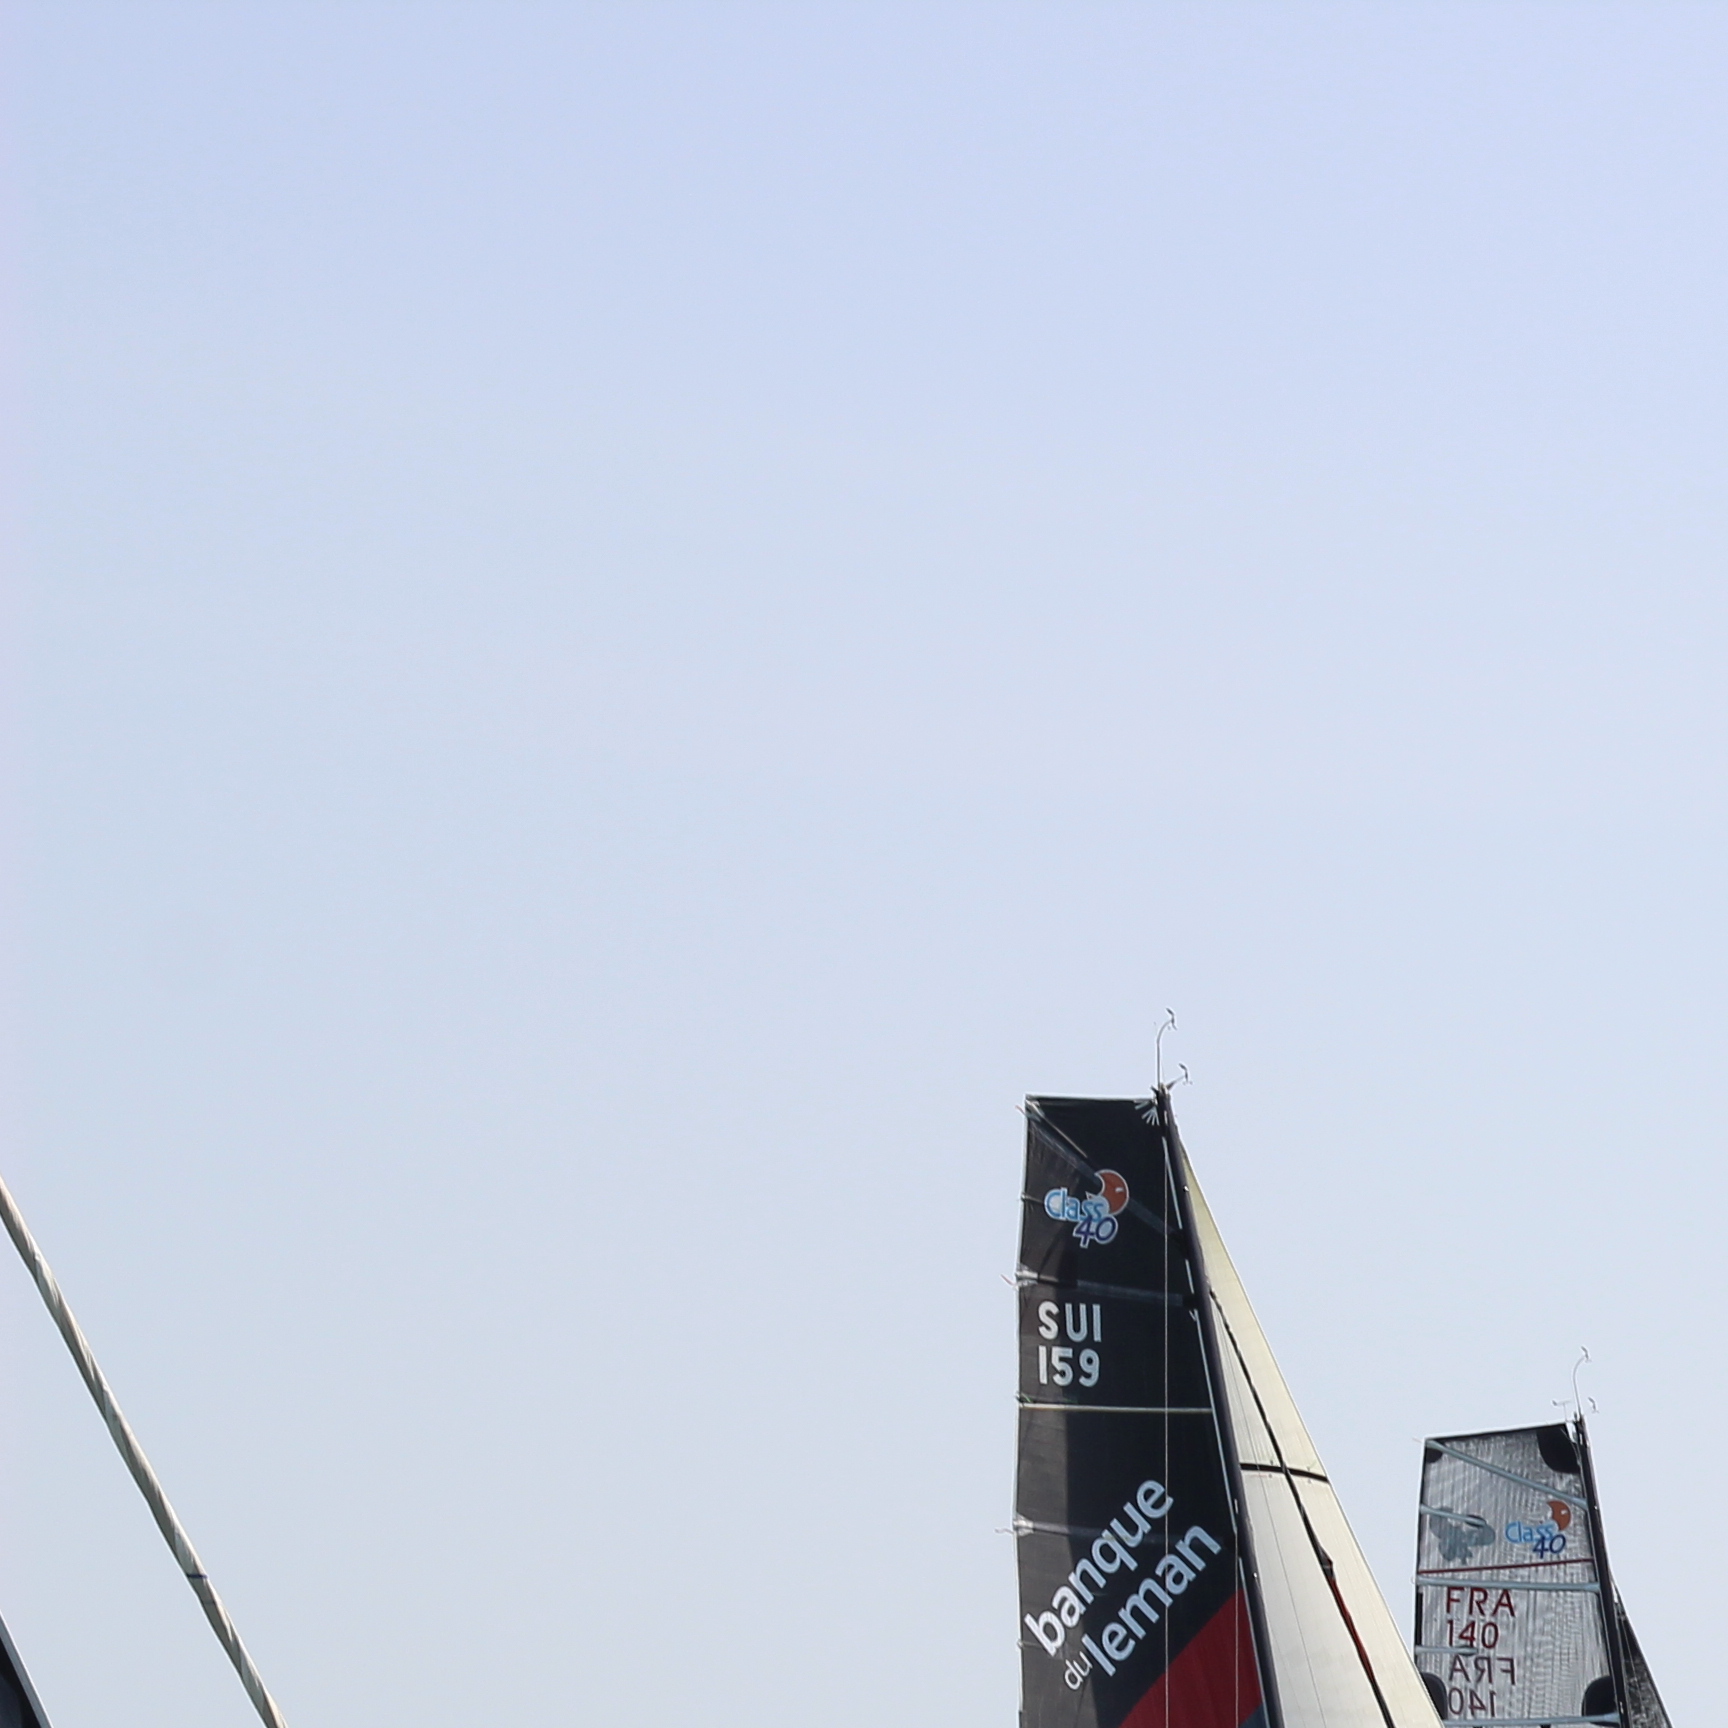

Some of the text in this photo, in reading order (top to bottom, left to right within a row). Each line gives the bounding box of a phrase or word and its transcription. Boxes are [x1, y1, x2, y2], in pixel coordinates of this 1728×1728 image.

[1045, 1186, 1104, 1222] Class
[1073, 1215, 1119, 1249] 40
[1037, 1300, 1102, 1343] SUI
[1037, 1345, 1100, 1388] 159
[1531, 1532, 1567, 1560] 40
[1024, 1479, 1174, 1656] banque
[1064, 1525, 1222, 1690] du leman
[1445, 1585, 1517, 1618] FRA
[1446, 1619, 1500, 1650] 140
